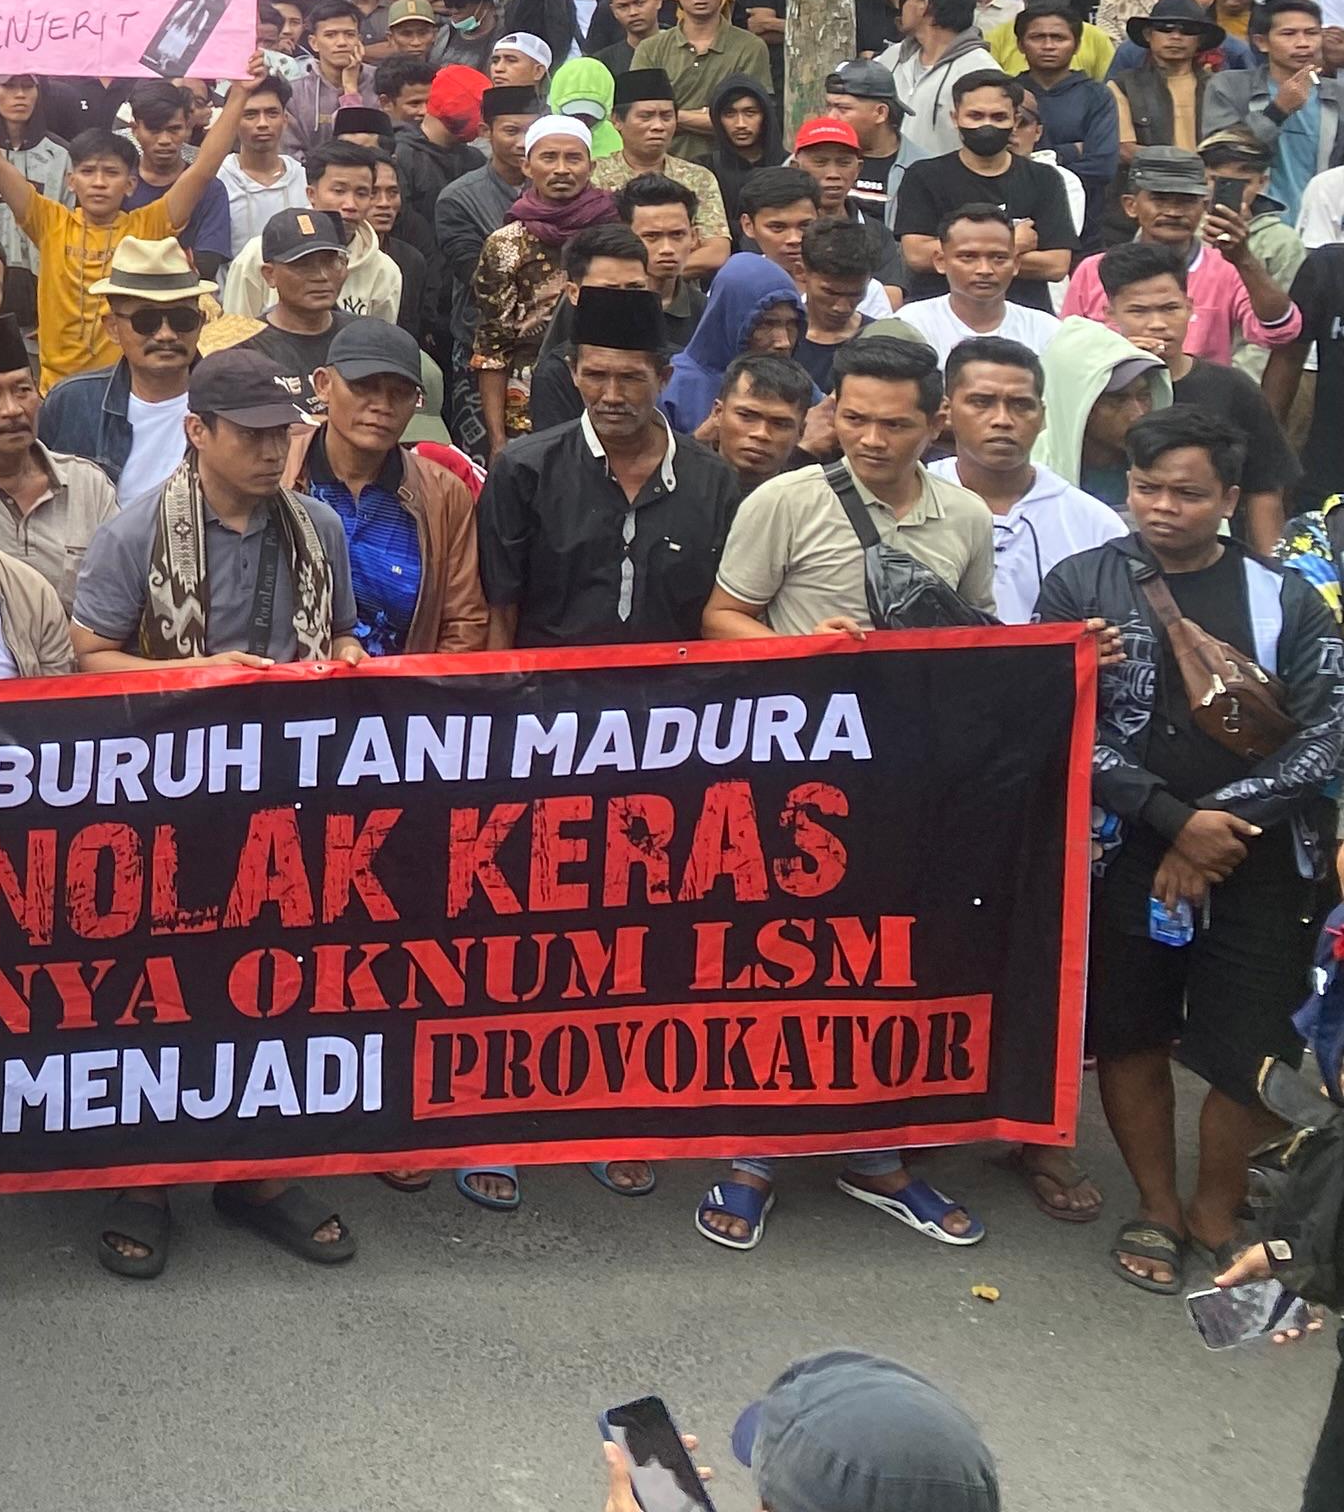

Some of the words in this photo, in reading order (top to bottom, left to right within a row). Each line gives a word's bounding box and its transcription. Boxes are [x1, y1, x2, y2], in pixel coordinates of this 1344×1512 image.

[283, 714, 492, 789] TANI
[510, 692, 874, 780] MADURA
[446, 780, 850, 918] KERAS
[227, 925, 649, 1018] OKNUM
[689, 914, 916, 991] LSM
[1, 1033, 385, 1133] MENJADI
[427, 1010, 976, 1105] PROVOKATOR
